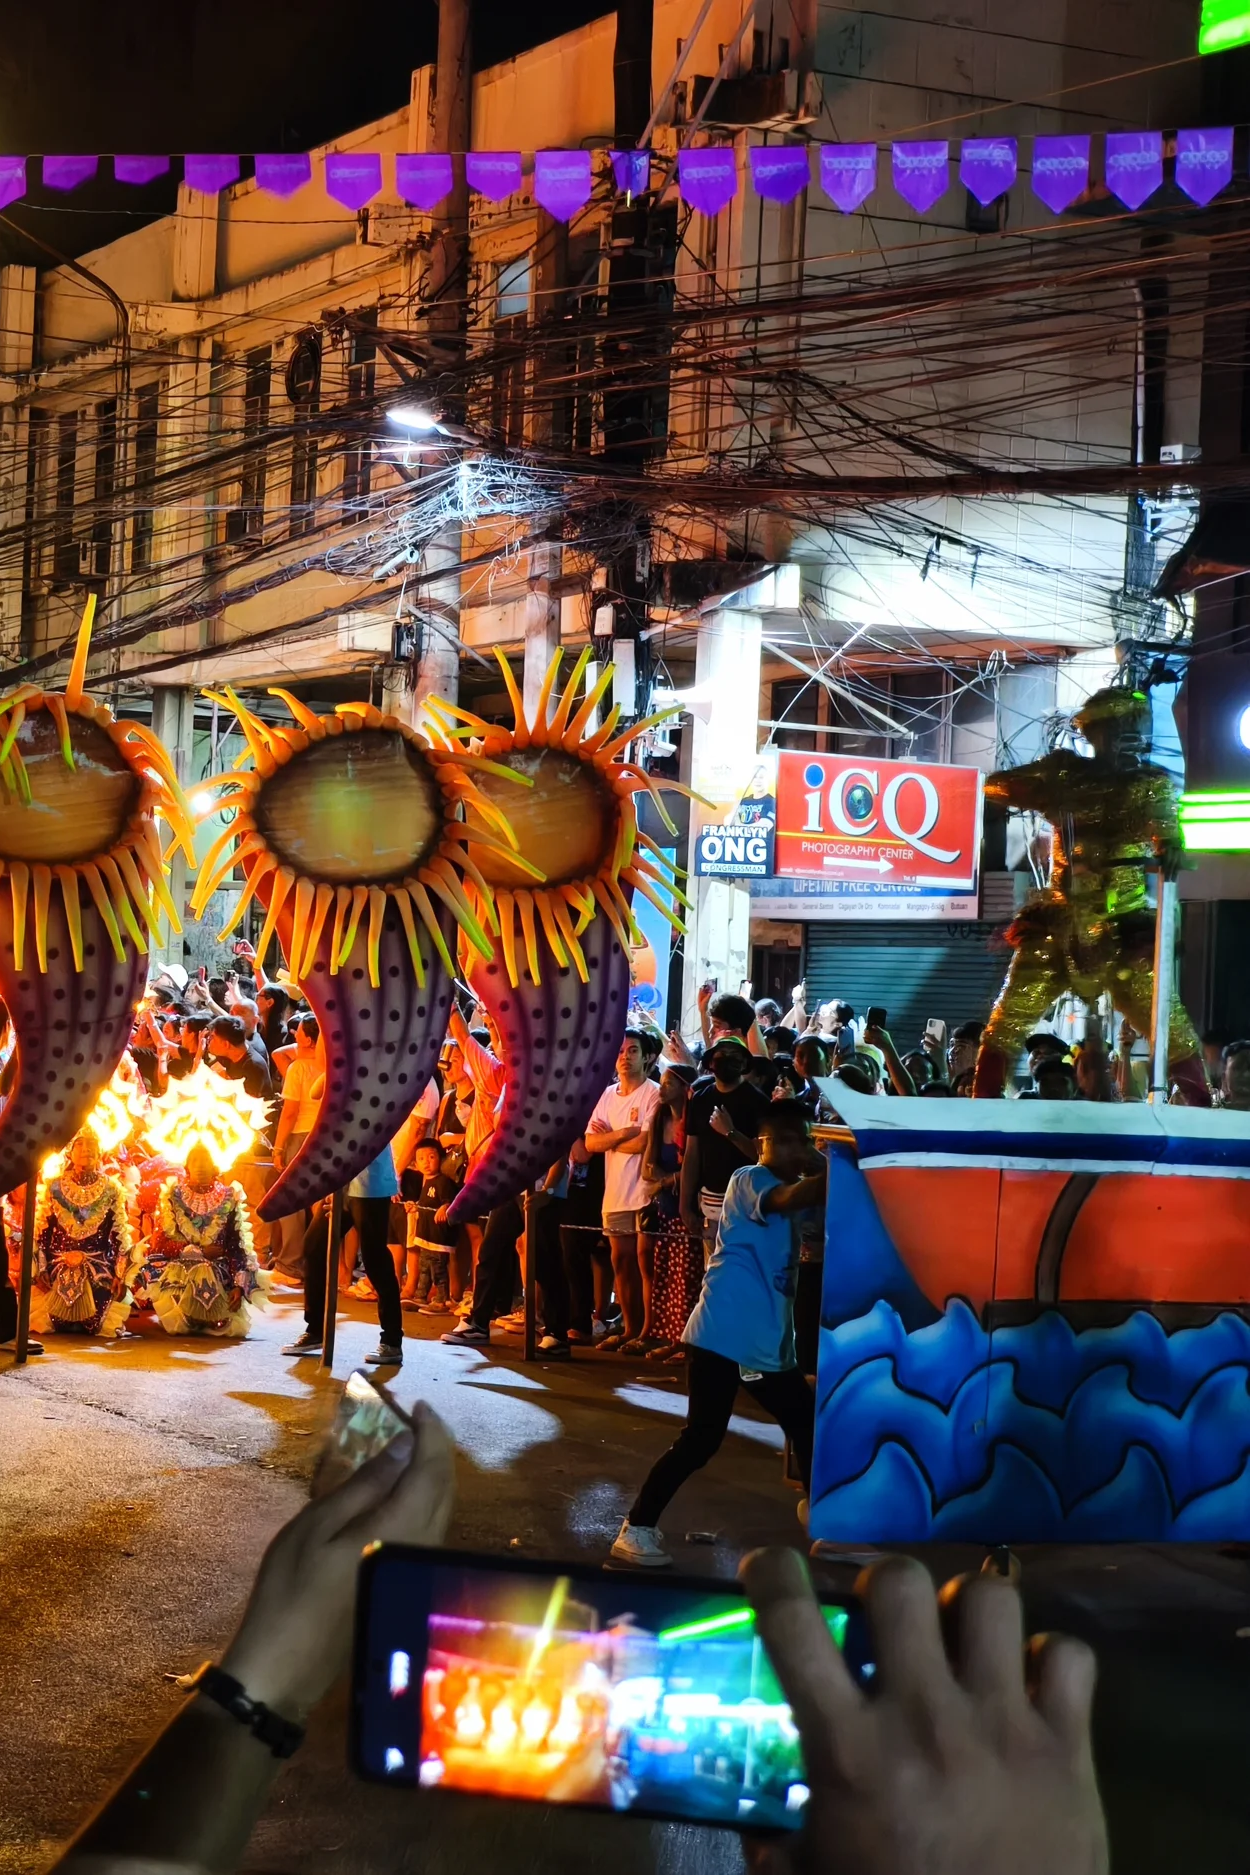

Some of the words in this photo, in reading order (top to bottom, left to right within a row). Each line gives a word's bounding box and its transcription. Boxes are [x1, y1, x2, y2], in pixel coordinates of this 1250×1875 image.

[802, 762, 961, 864] iCQ
[702, 825, 767, 838] FRANKLYN
[701, 836, 767, 863] ONG
[801, 841, 876, 858] PHOTOGRAPHY
[878, 847, 914, 861] CENTER
[704, 864, 763, 873] CONGRESSMAN
[793, 880, 840, 893] LIFETIME
[843, 882, 871, 892] FREE
